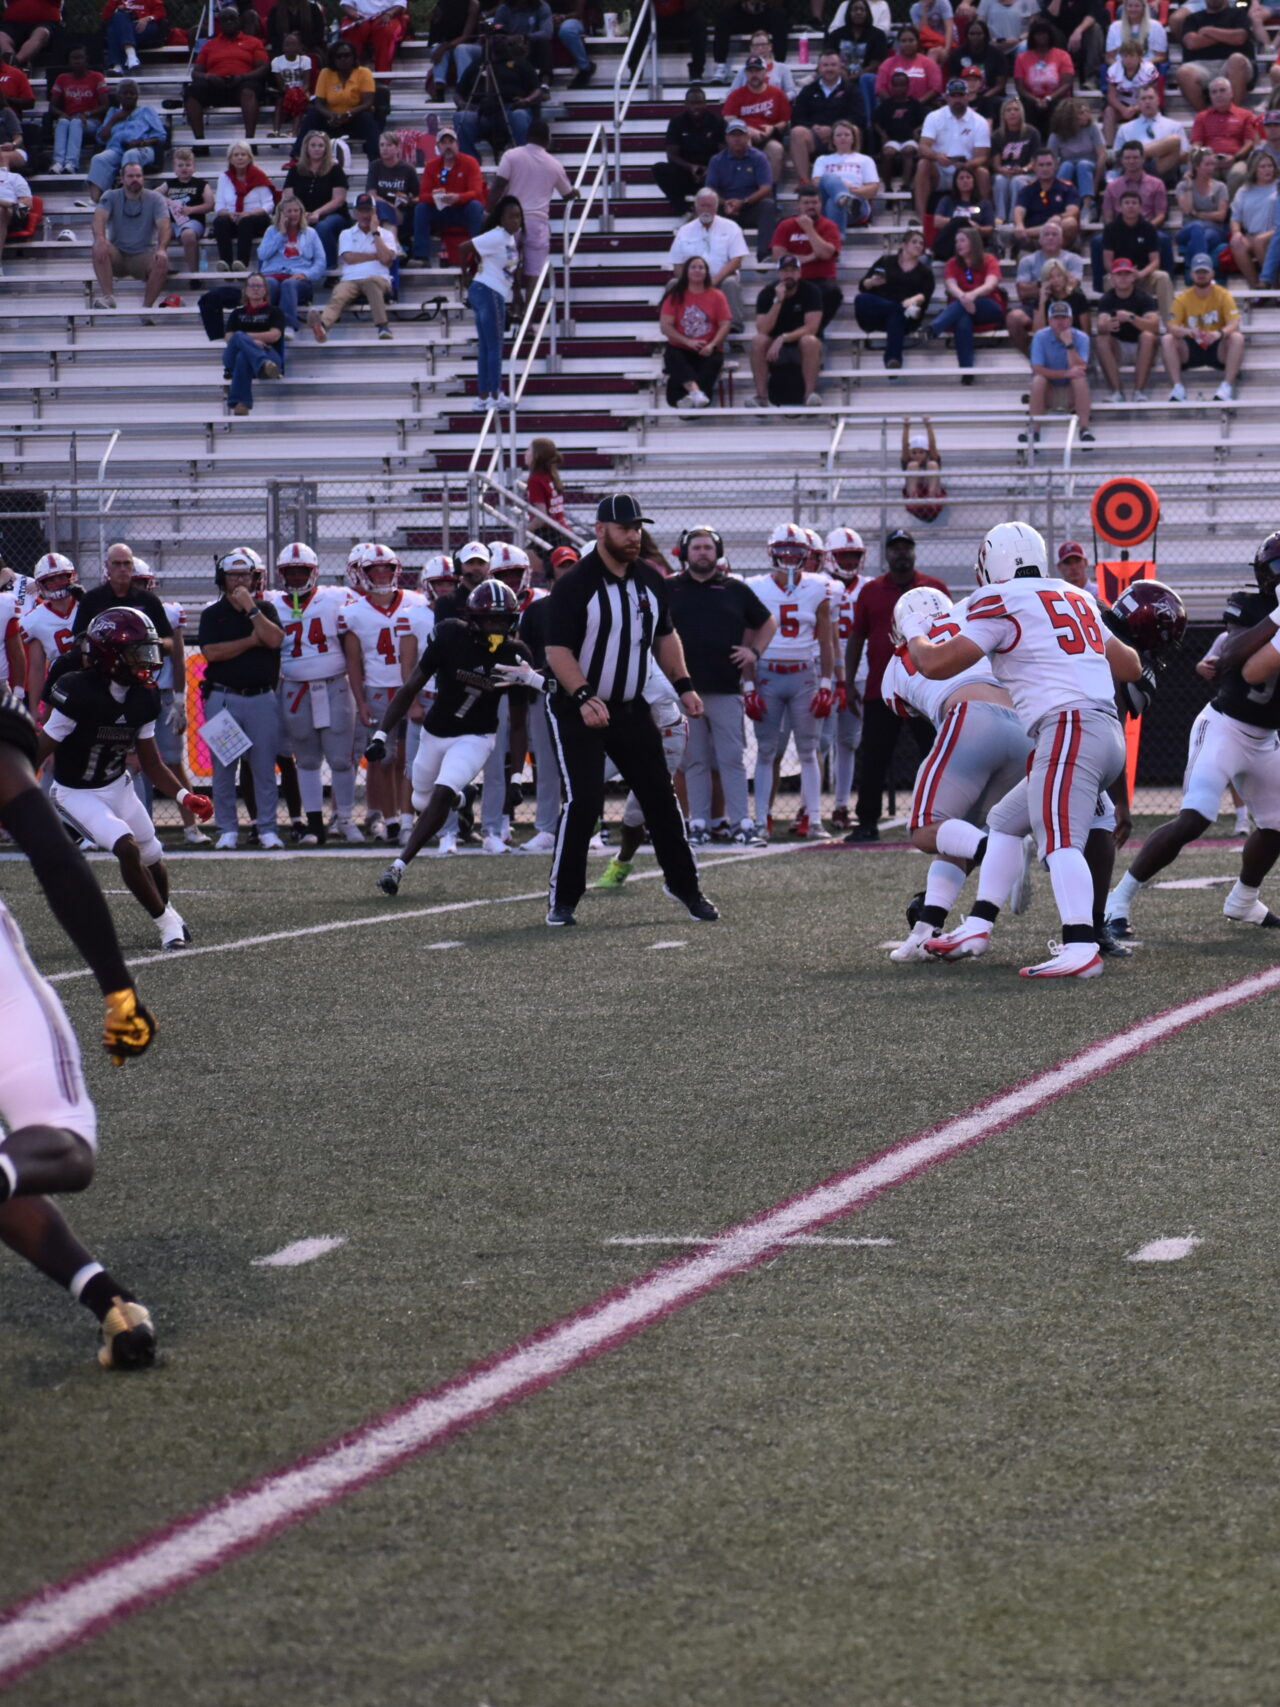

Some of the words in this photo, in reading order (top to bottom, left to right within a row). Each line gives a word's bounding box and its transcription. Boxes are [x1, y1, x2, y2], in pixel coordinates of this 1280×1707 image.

[284, 617, 328, 658] 74
[779, 604, 800, 638] 5
[1036, 590, 1105, 655] 58
[453, 685, 482, 718] 7
